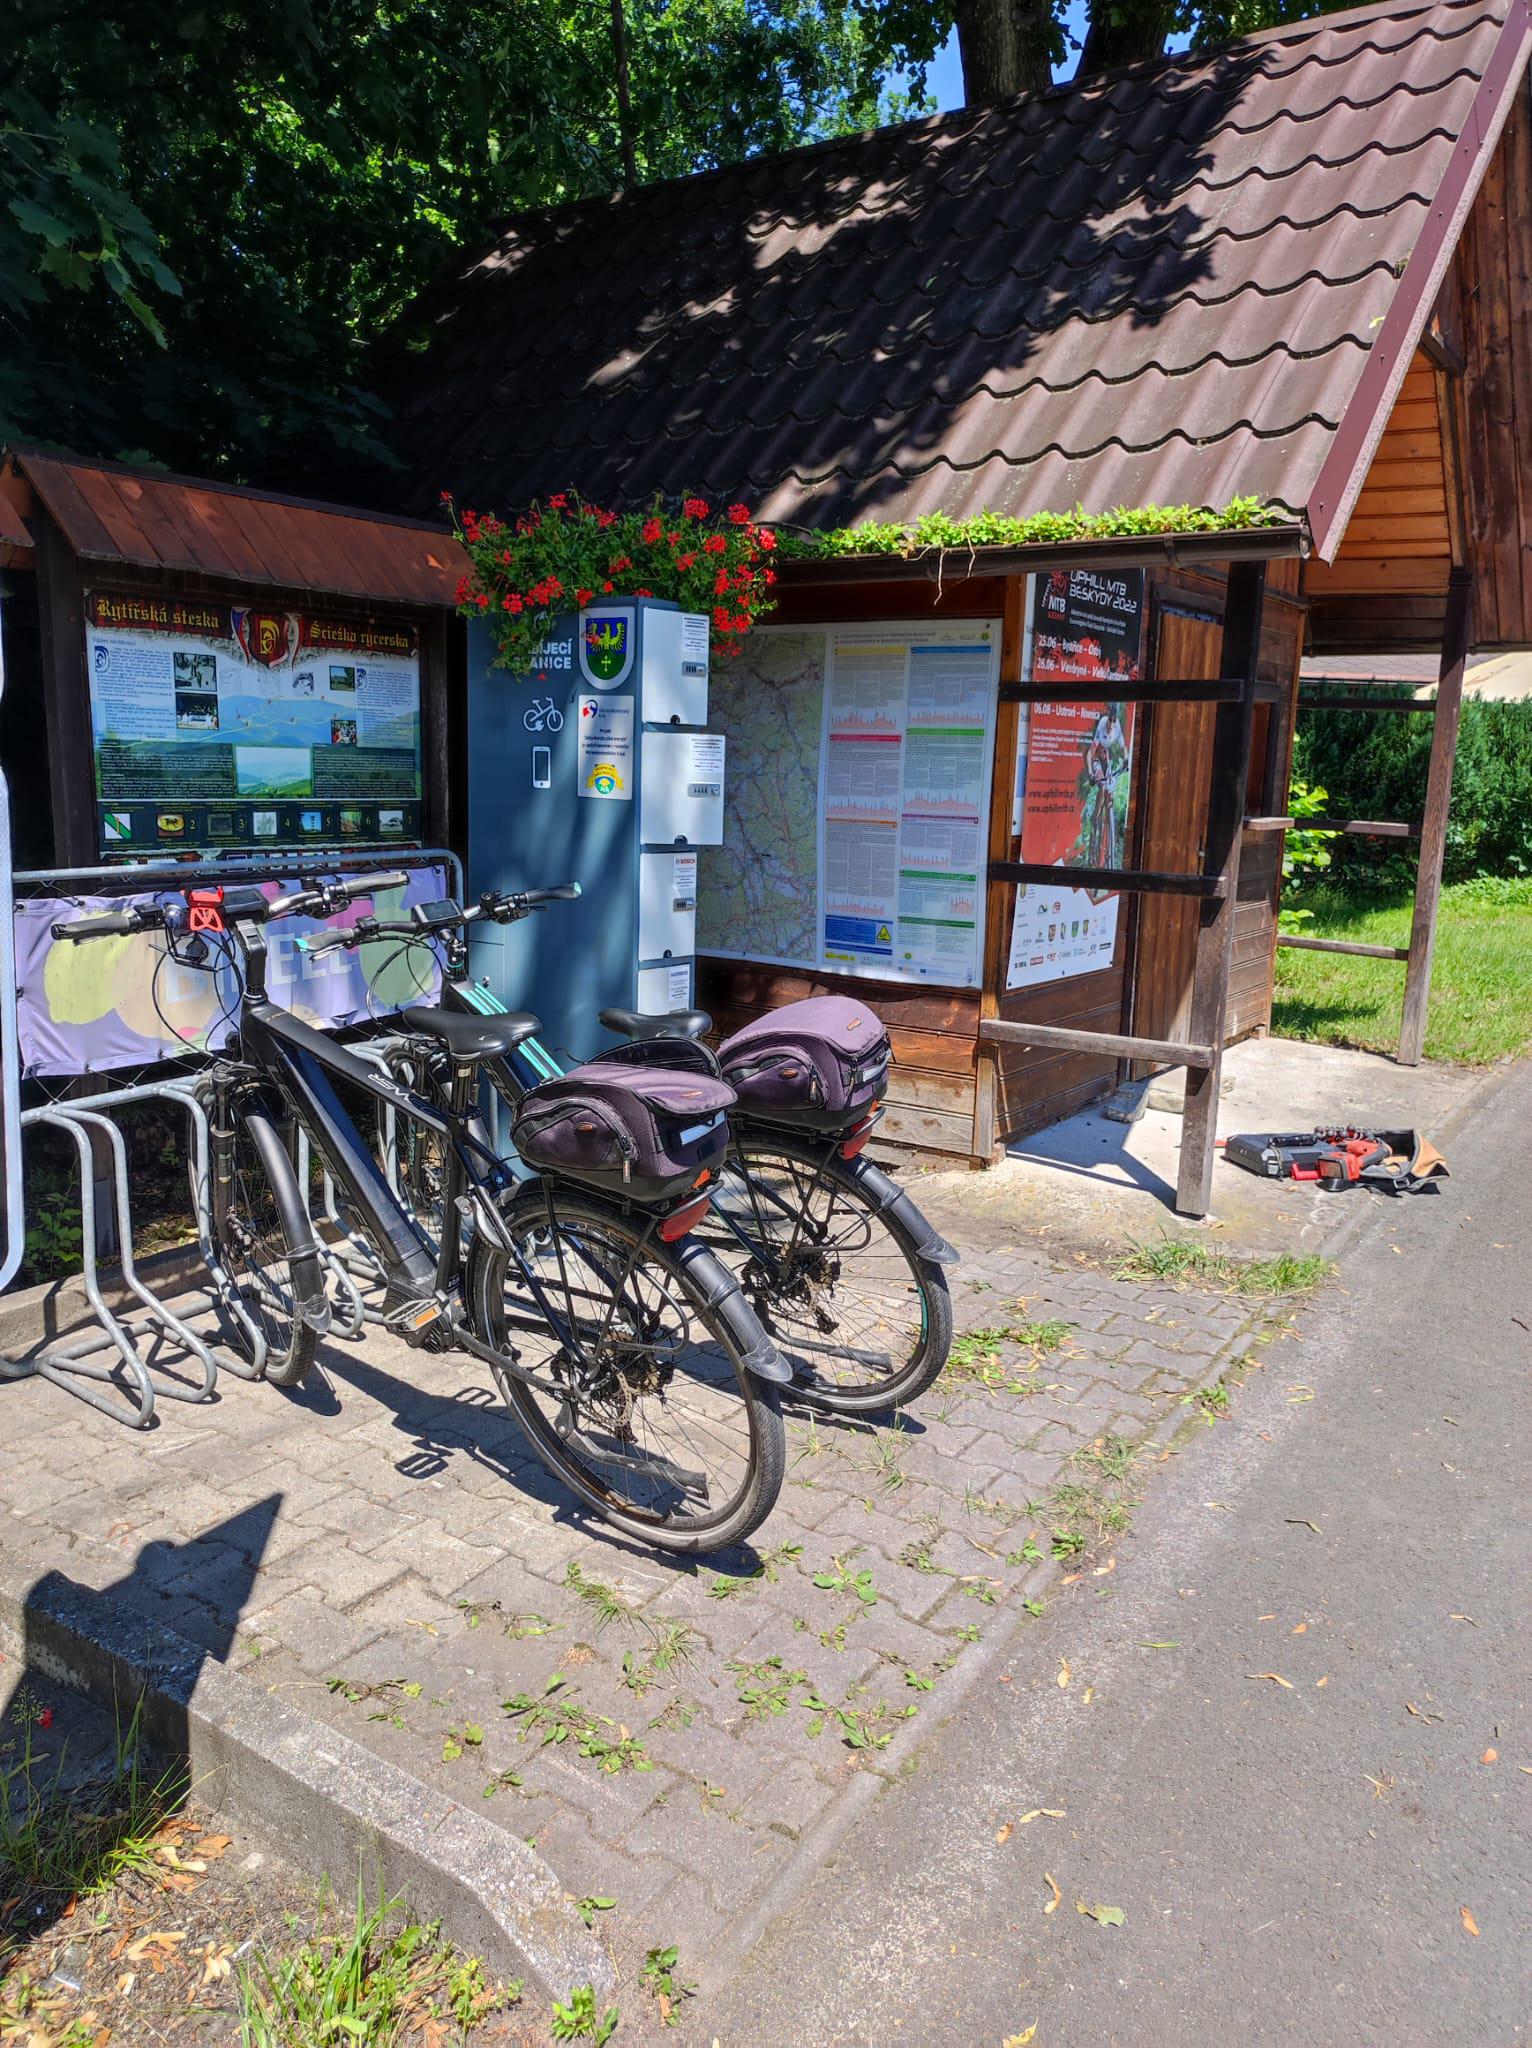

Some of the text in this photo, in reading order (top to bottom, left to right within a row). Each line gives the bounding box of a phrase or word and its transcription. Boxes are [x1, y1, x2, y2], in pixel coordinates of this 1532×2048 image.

[1070, 570, 1127, 596] UPHILL MTB
[1048, 595, 1066, 613] MTB
[1069, 583, 1137, 614] BESKYDY 2022
[97, 599, 219, 629] Rytířská stezka
[310, 620, 409, 648] Ścieżka rycerska
[1038, 634, 1057, 648] 25.06
[529, 657, 572, 669] ANICE
[189, 819, 197, 830] 2
[238, 818, 246, 829] 3
[284, 817, 290, 828] 4
[325, 817, 331, 826] 5
[365, 816, 371, 825] 6
[345, 1203, 393, 1267] FOX
